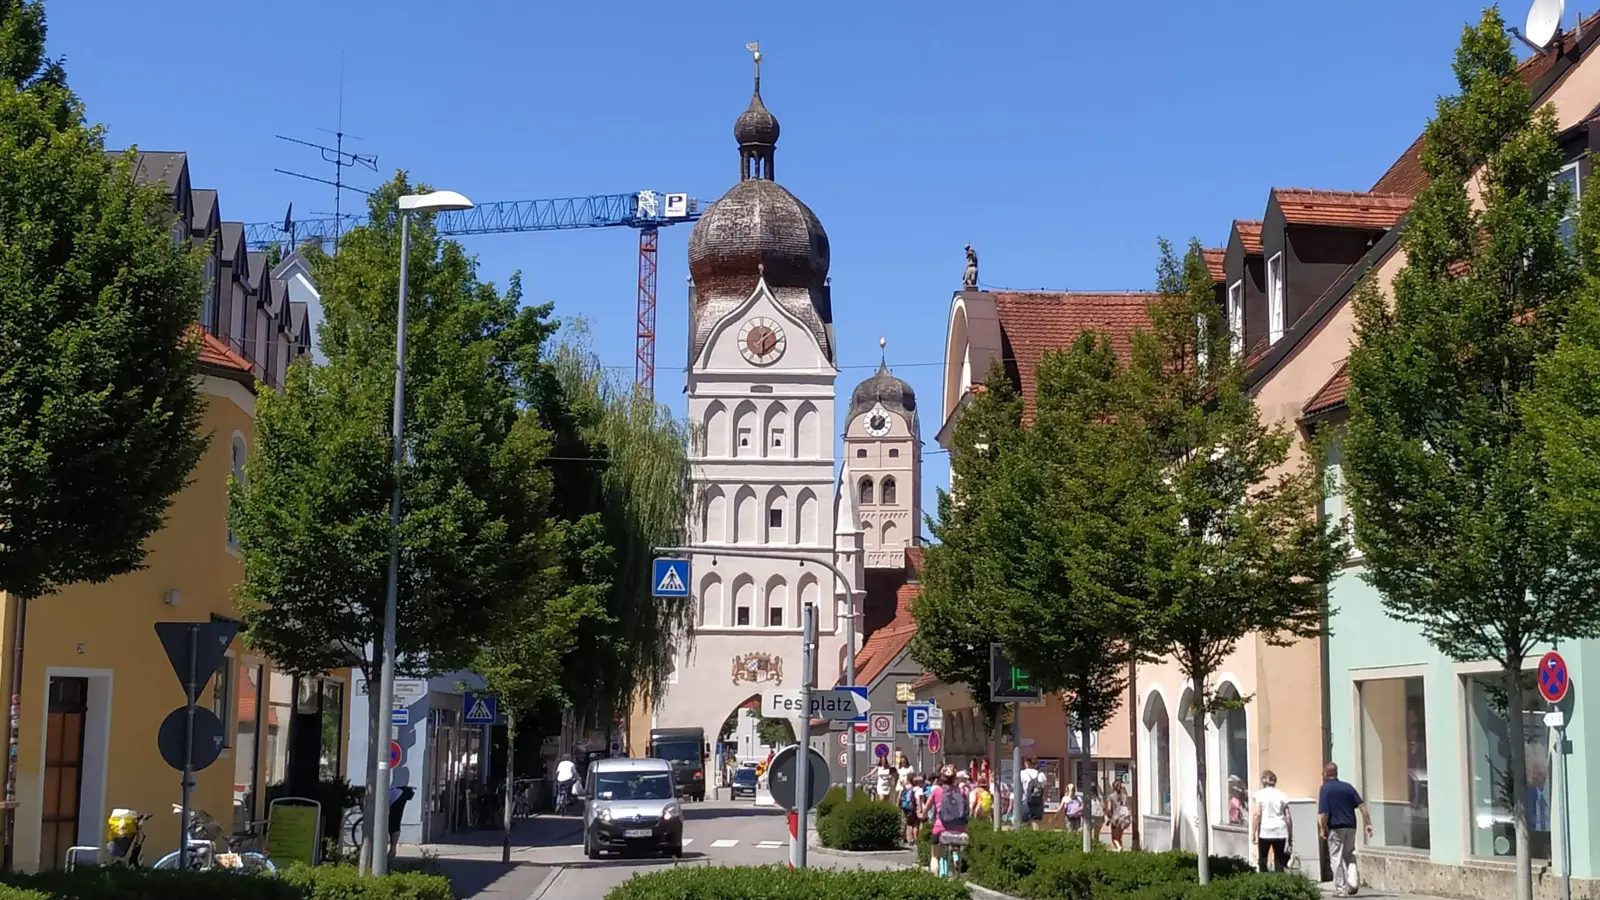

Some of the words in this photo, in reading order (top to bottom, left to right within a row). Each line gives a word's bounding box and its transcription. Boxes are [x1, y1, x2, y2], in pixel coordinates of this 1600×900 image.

[668, 196, 683, 208] P
[773, 694, 851, 714] Fesplatz
[878, 720, 888, 728] 30
[913, 709, 928, 731] P
